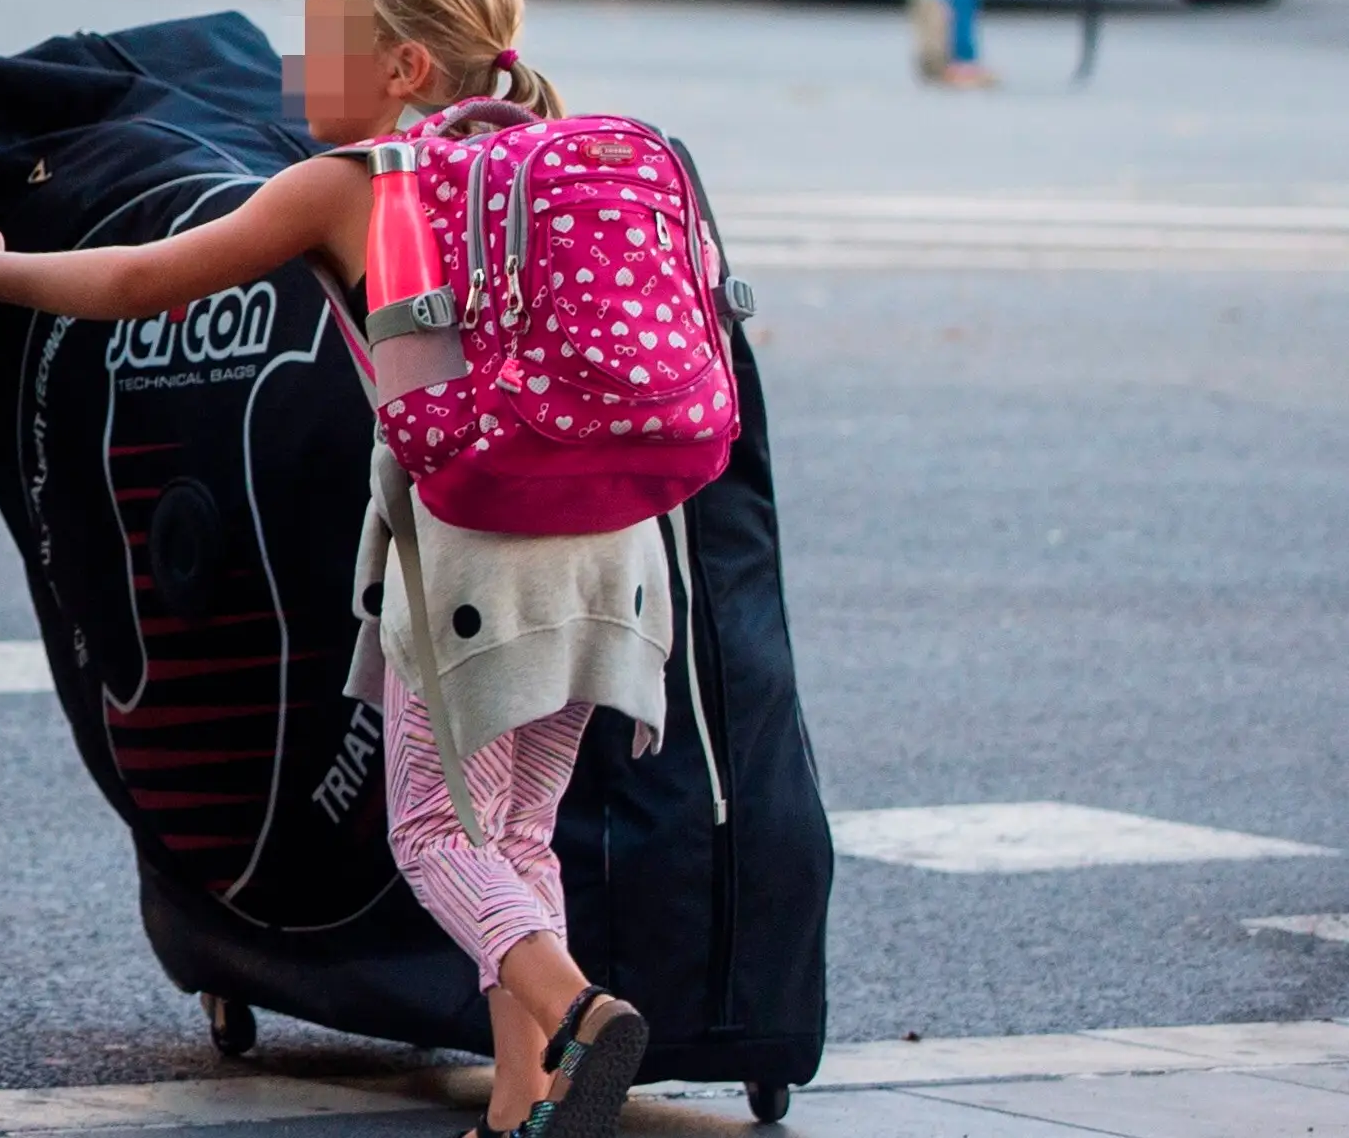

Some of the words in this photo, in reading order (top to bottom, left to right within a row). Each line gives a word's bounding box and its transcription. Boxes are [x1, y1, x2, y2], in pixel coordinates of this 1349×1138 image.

[116, 373, 205, 392] TECHNICAL
[210, 364, 258, 383] BAGS
[311, 702, 382, 824] TRIAT
